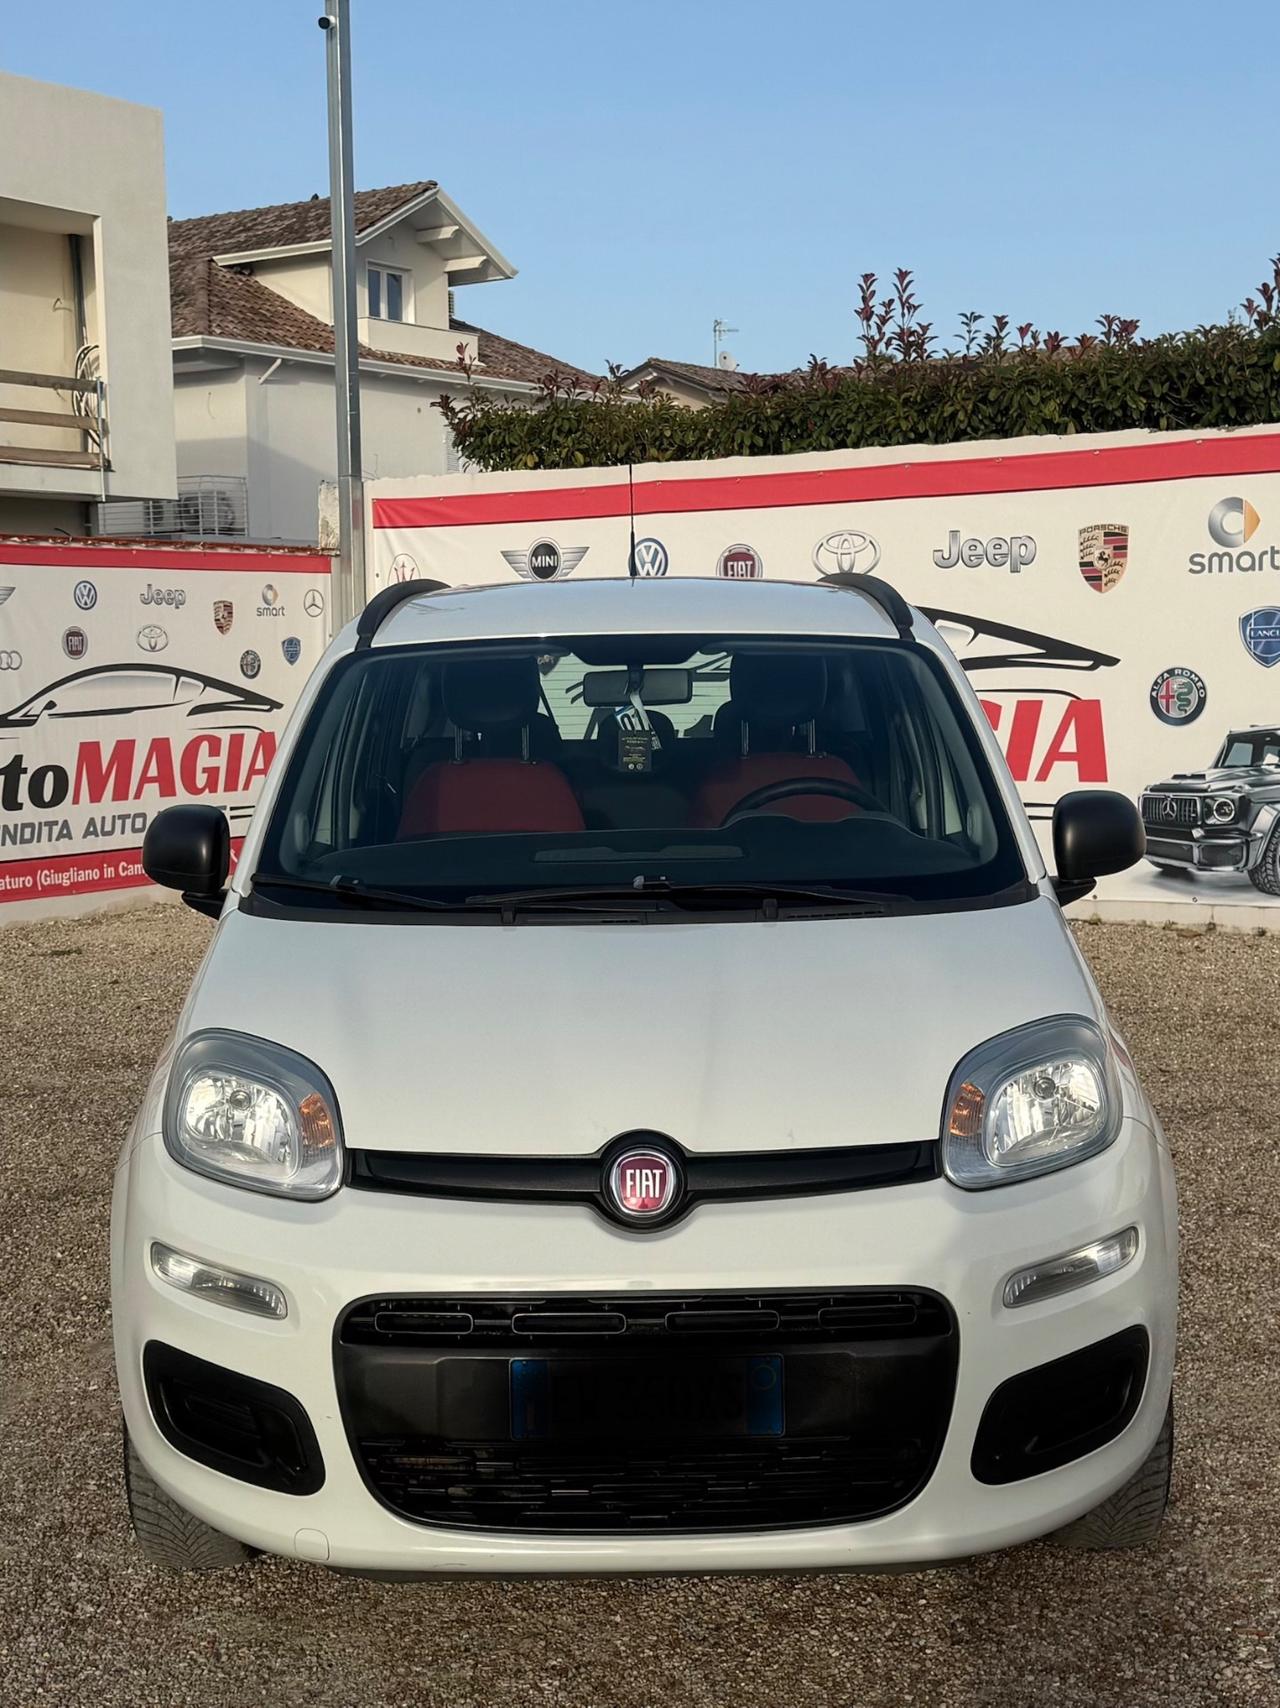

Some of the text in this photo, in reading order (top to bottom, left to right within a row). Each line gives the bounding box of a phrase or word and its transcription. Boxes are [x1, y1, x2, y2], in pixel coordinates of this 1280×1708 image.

[1080, 524, 1127, 534] PORSCHE
[531, 555, 558, 568] MINI
[933, 530, 1036, 573] Jeep
[1188, 546, 1280, 574] smart
[727, 561, 753, 578] FIAT
[140, 584, 186, 609] Jeep
[256, 606, 285, 617] smart
[1174, 669, 1206, 698] ROMEO
[0, 812, 148, 847] NDITA AUTO
[36, 863, 100, 891] (Giugliano
[103, 864, 115, 878] in
[625, 1168, 664, 1198] FIAT
